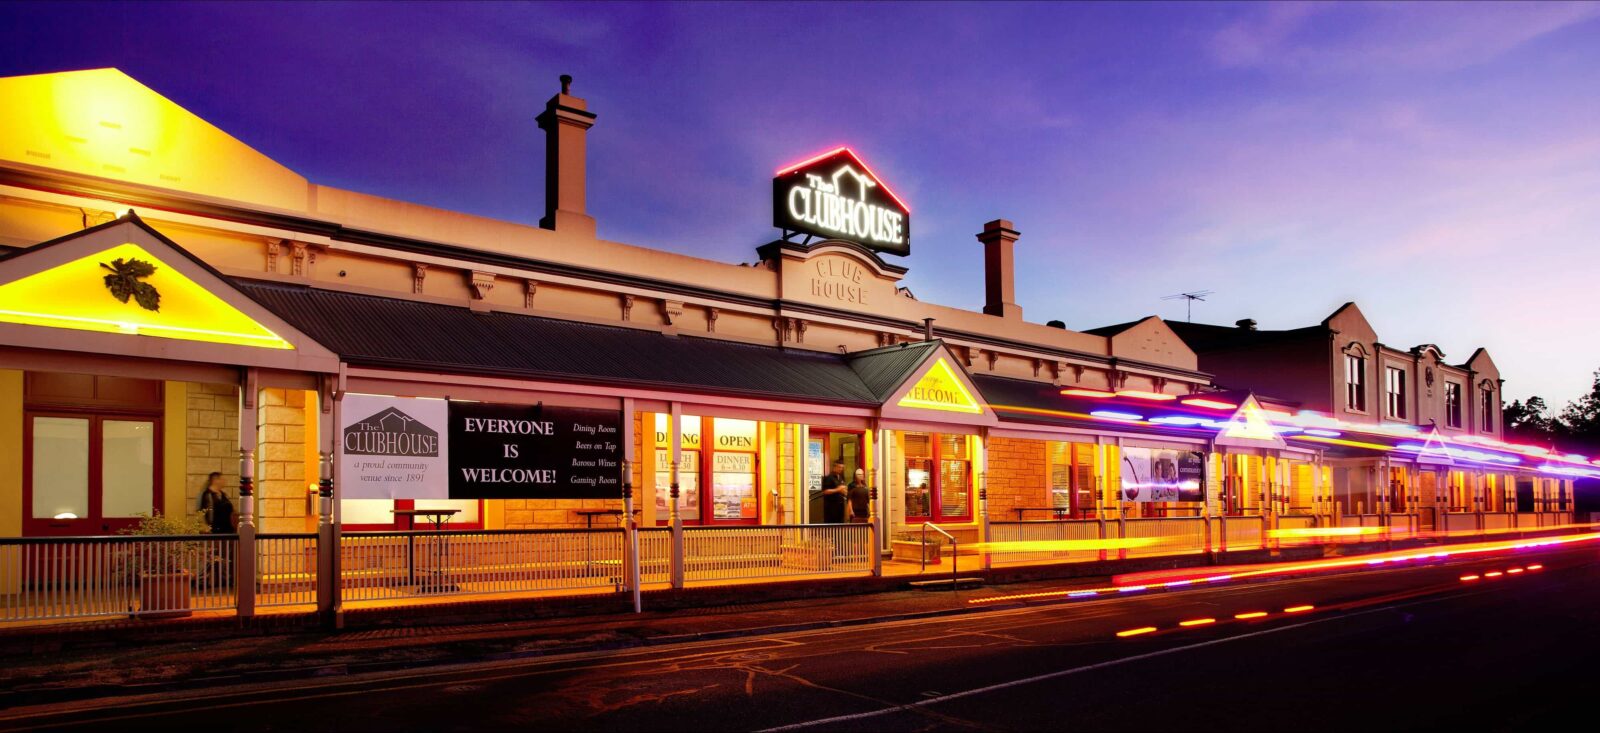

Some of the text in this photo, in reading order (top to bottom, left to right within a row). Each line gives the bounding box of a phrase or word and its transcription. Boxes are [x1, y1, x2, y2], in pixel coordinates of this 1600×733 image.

[806, 173, 834, 193] The
[788, 186, 902, 244] CLUBHOUSE
[816, 259, 862, 284] CLUB
[810, 278, 869, 305] HOUSE
[358, 422, 380, 431] The
[464, 417, 554, 436] EVERYONE
[573, 423, 617, 435] Dining Room
[345, 432, 438, 455] CLUBHOUSE
[656, 432, 699, 445] DING
[719, 435, 752, 447] OPEN
[503, 444, 519, 458] IS
[575, 441, 592, 450] Beers
[605, 442, 617, 453] Tap
[572, 458, 617, 467] Barossa Wines
[717, 455, 750, 464] DINNER
[361, 461, 385, 471] proud
[387, 462, 429, 473] community
[384, 474, 403, 482] since
[406, 474, 425, 482] 1891
[461, 468, 557, 484] WELCOME!
[570, 475, 617, 487] Gaming Room
